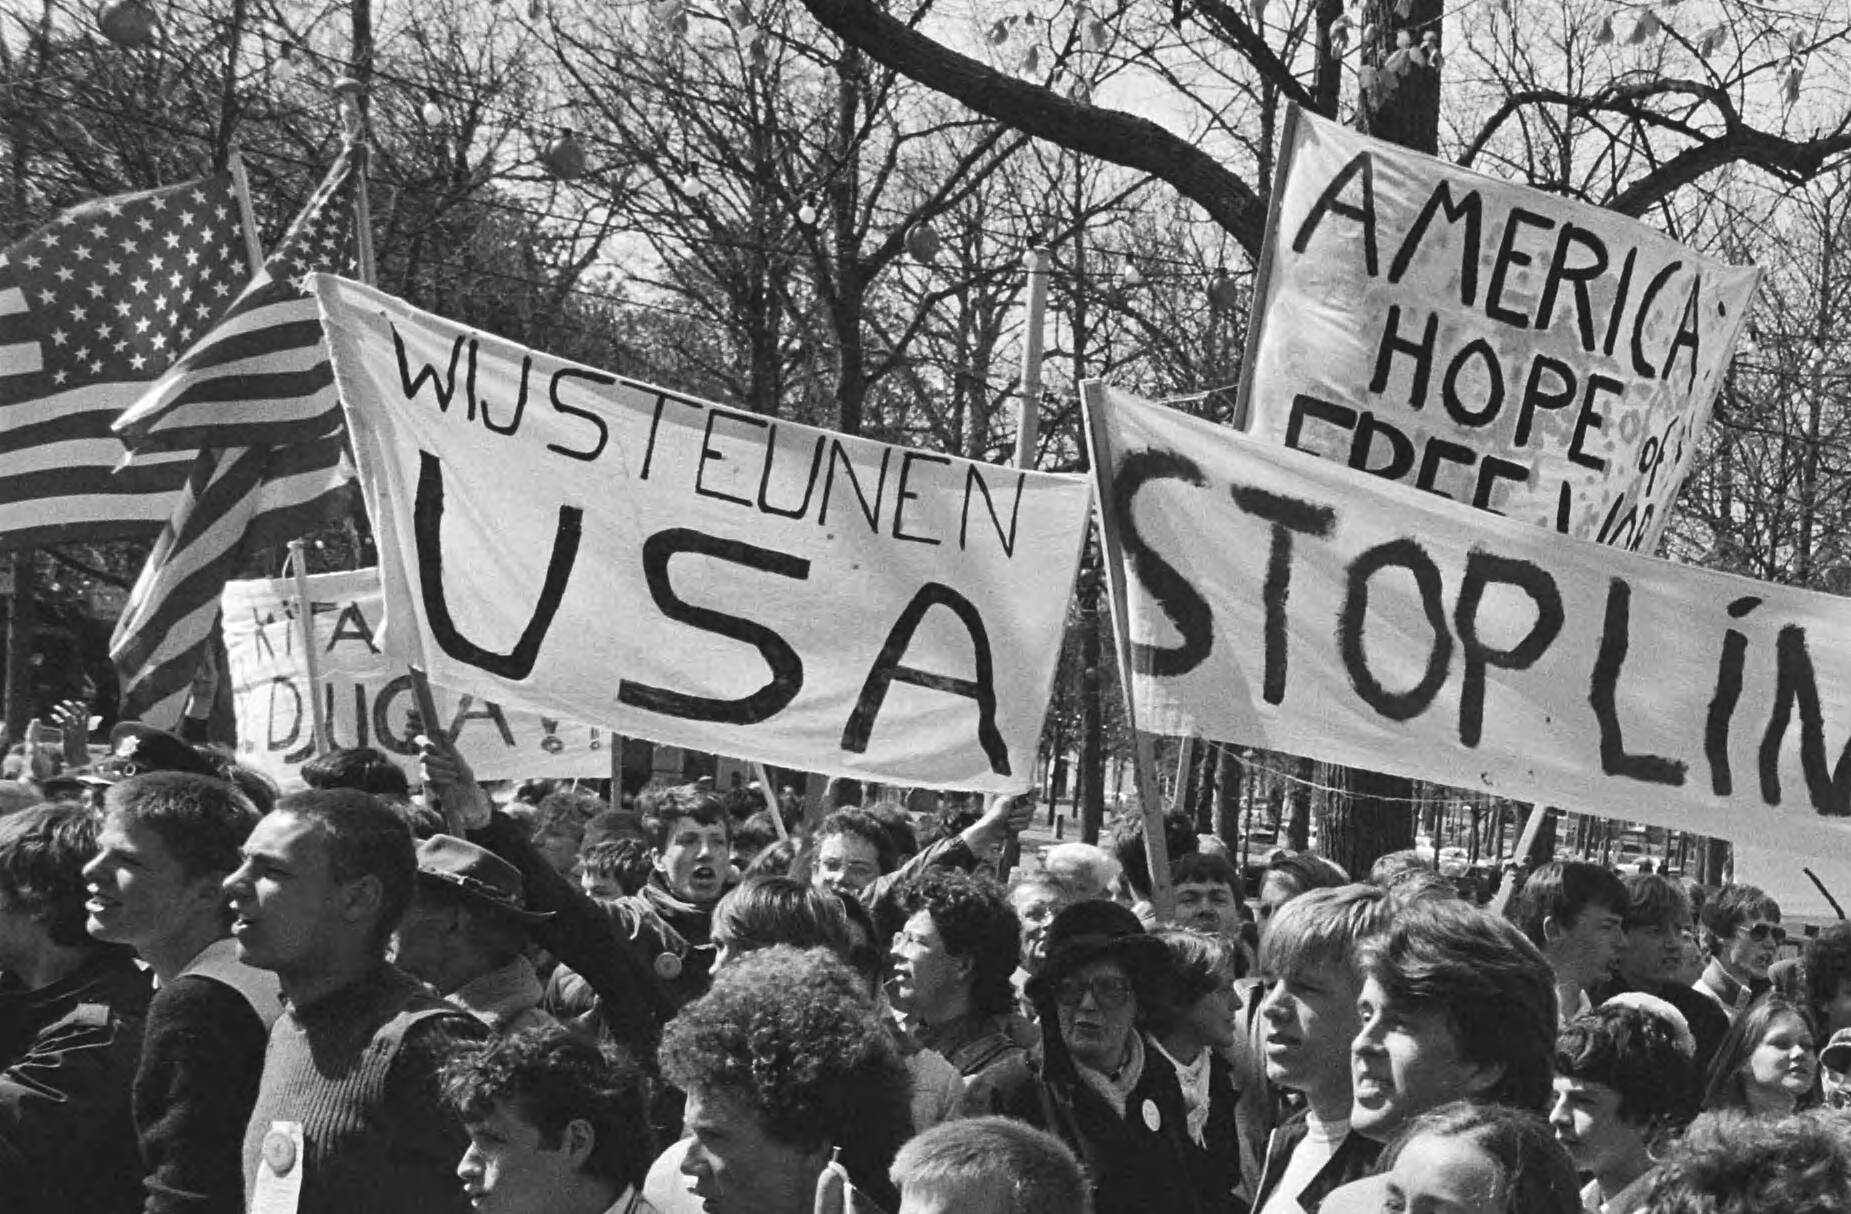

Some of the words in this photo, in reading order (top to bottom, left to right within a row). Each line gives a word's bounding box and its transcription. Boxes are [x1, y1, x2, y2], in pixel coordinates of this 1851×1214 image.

[389, 321, 536, 437] WIJ
[547, 366, 1026, 558] STEUNEN
[1368, 304, 1625, 472] HOPE
[414, 449, 1012, 777] USA
[1112, 447, 1565, 748] STOP
